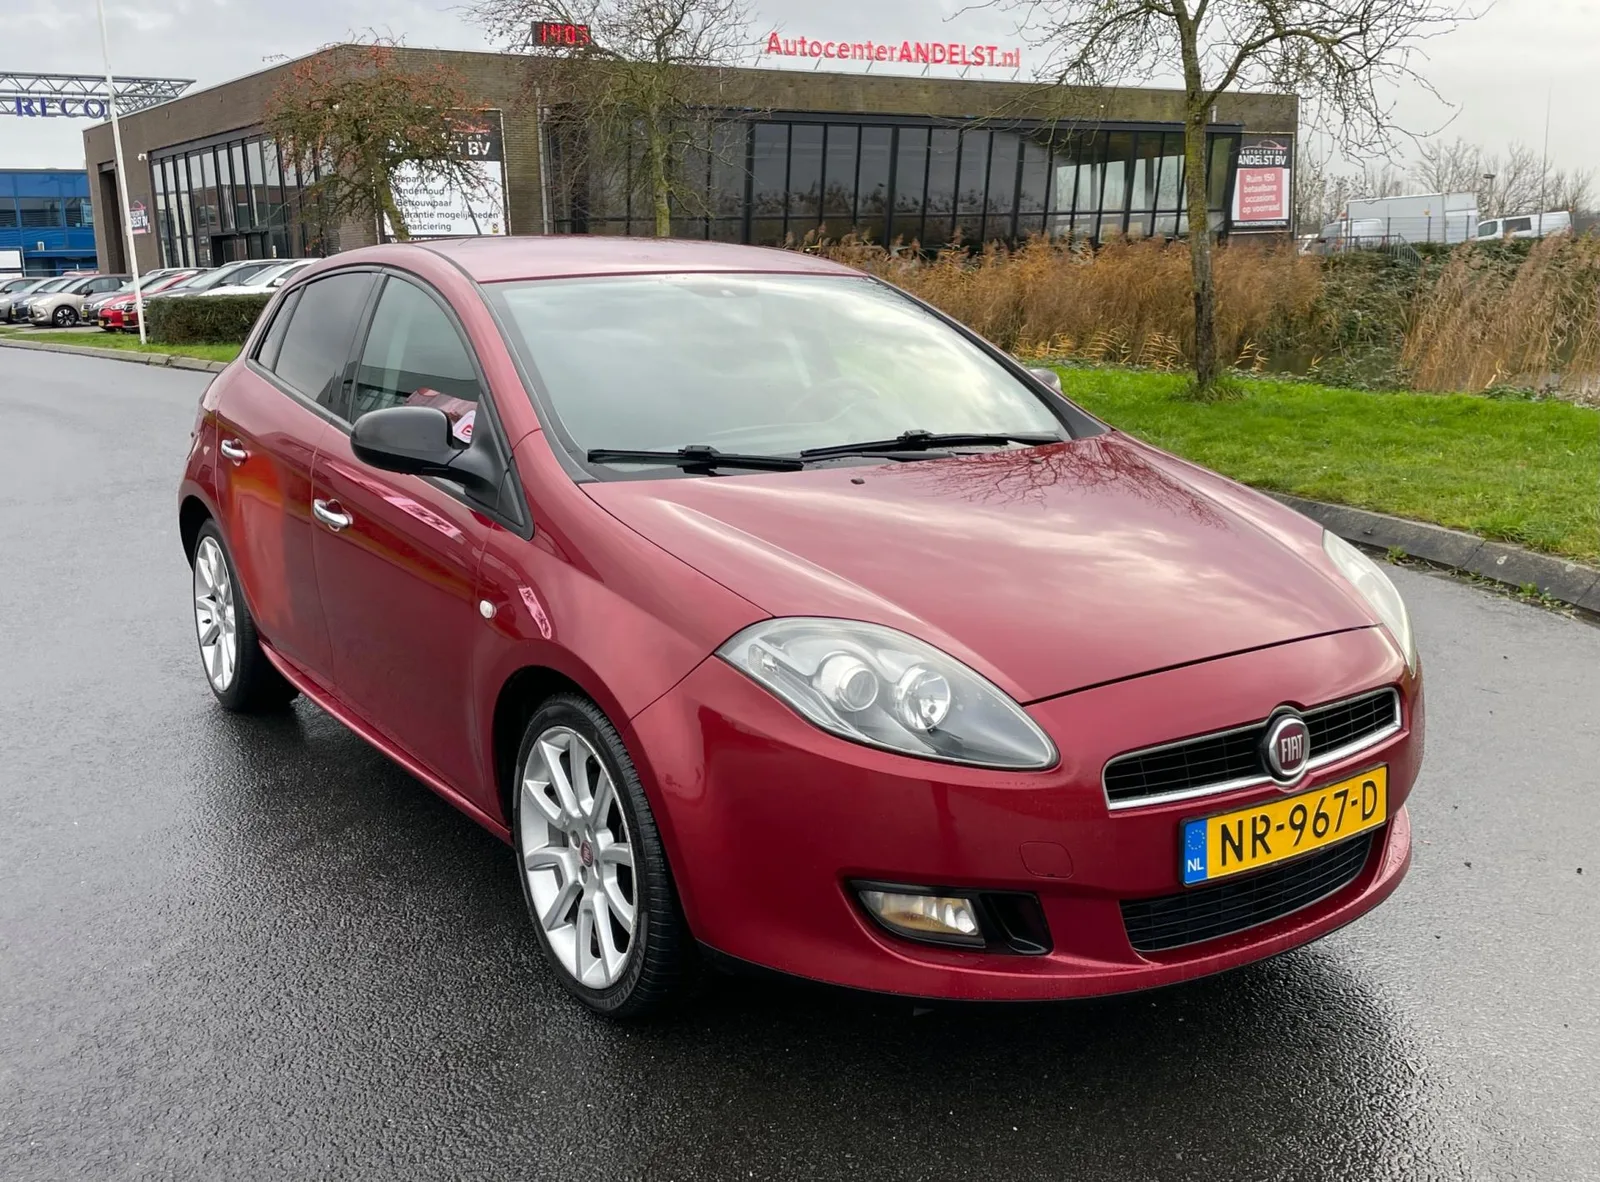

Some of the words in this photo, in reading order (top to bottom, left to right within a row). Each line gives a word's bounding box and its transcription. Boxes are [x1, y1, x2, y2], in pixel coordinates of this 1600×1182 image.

[767, 32, 1020, 68] AutocenterANDELST.nl
[467, 141, 491, 155] BV
[1238, 155, 1274, 165] ANDELST
[1275, 155, 1287, 165] BV
[1264, 173, 1275, 182] 150
[401, 210, 435, 219] arantie
[1281, 733, 1304, 764] FIAT
[1220, 780, 1378, 867] NR-967-D
[1187, 859, 1205, 874] NL
